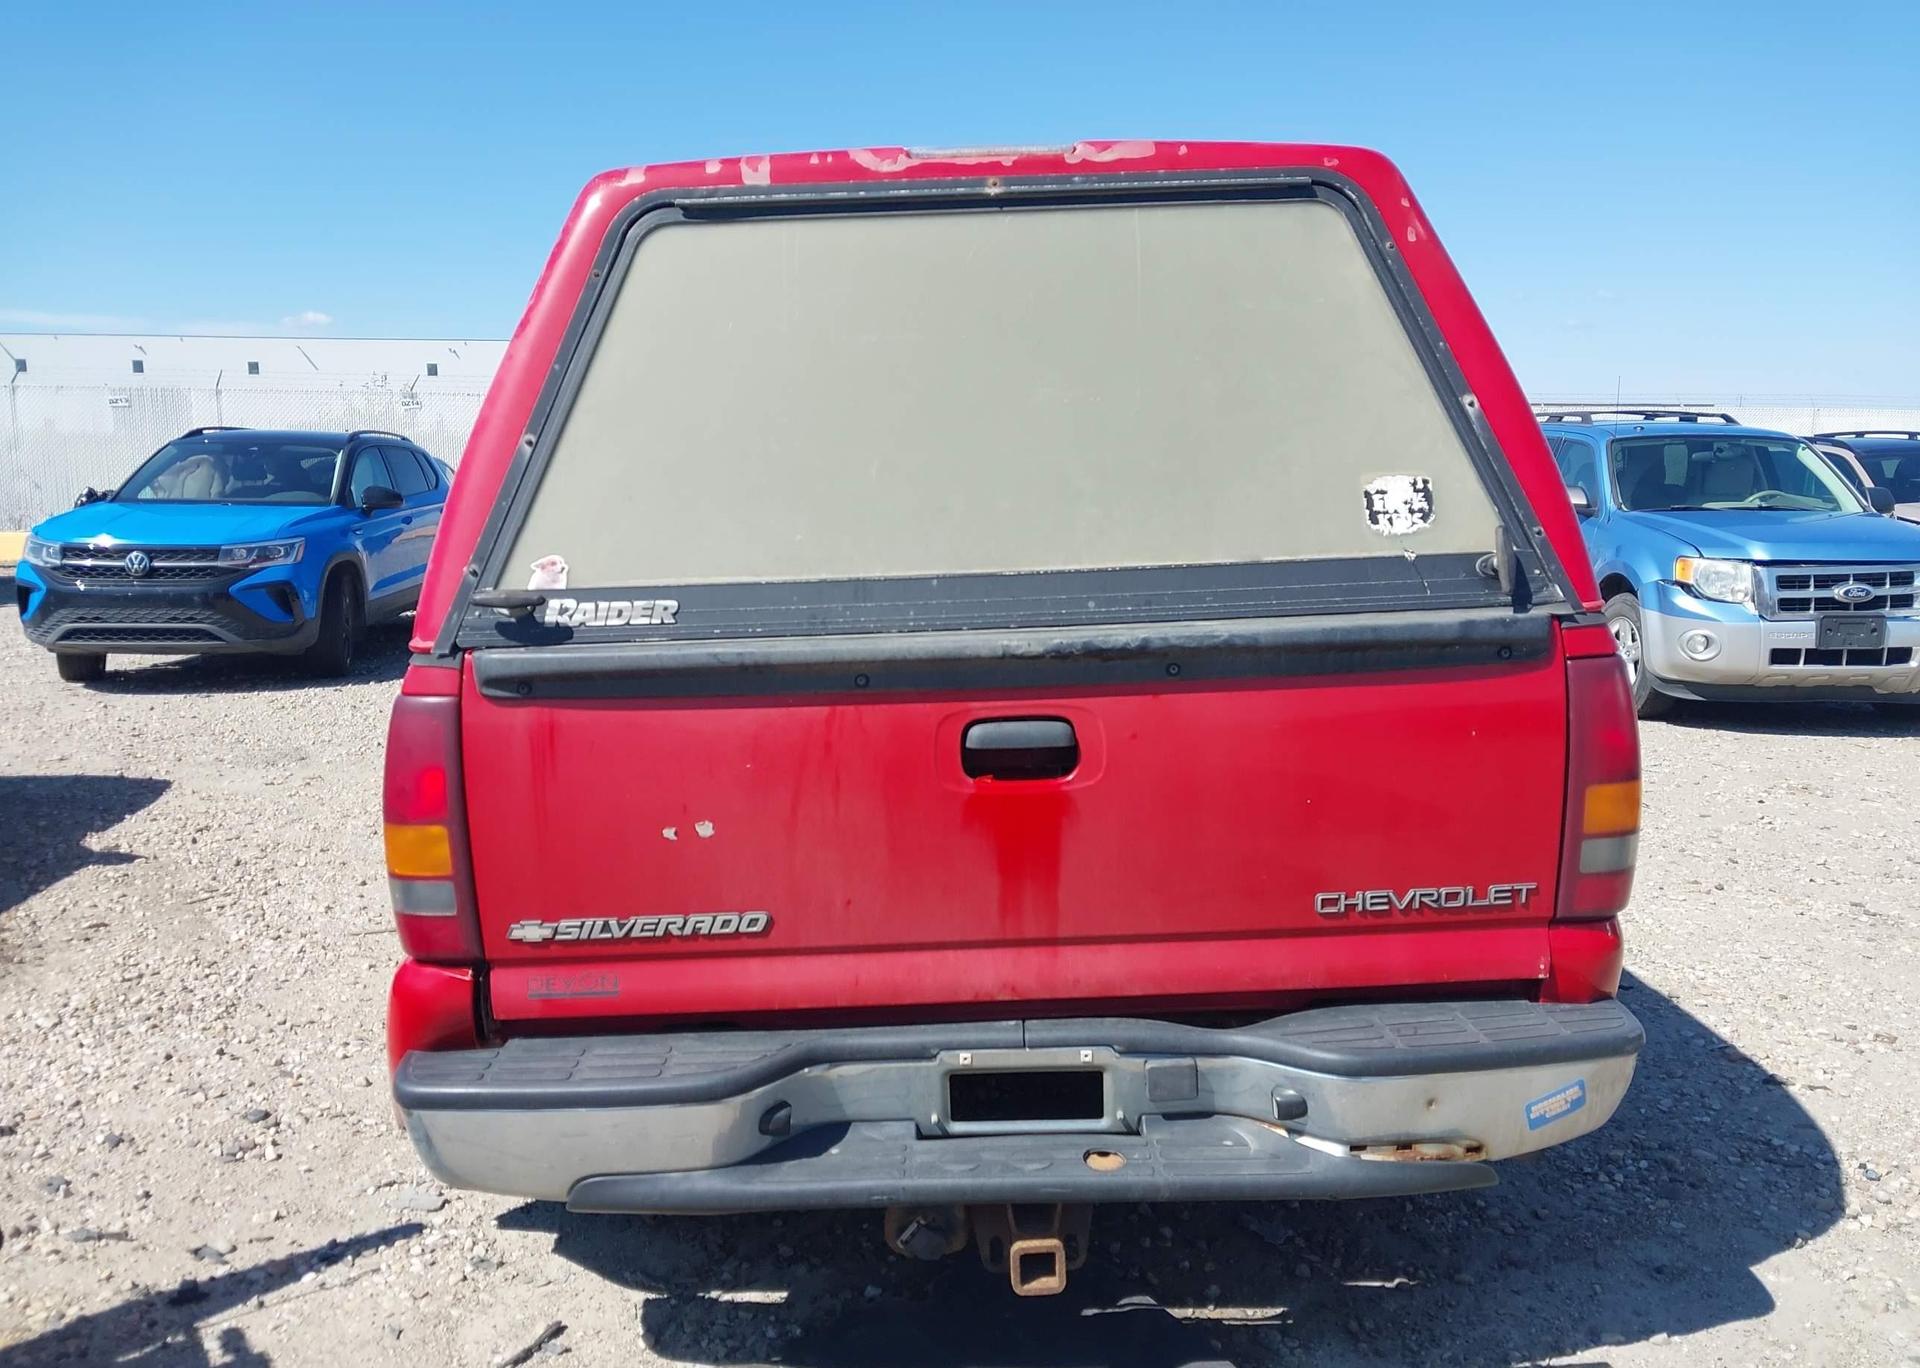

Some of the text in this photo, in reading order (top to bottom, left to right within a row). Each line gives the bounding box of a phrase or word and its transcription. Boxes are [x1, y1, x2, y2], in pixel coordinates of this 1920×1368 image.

[544, 599, 680, 626] RAIDER
[1315, 882, 1537, 913] CHEVROLET
[554, 911, 770, 941] SILVERADO
[527, 972, 619, 993] DEVON
